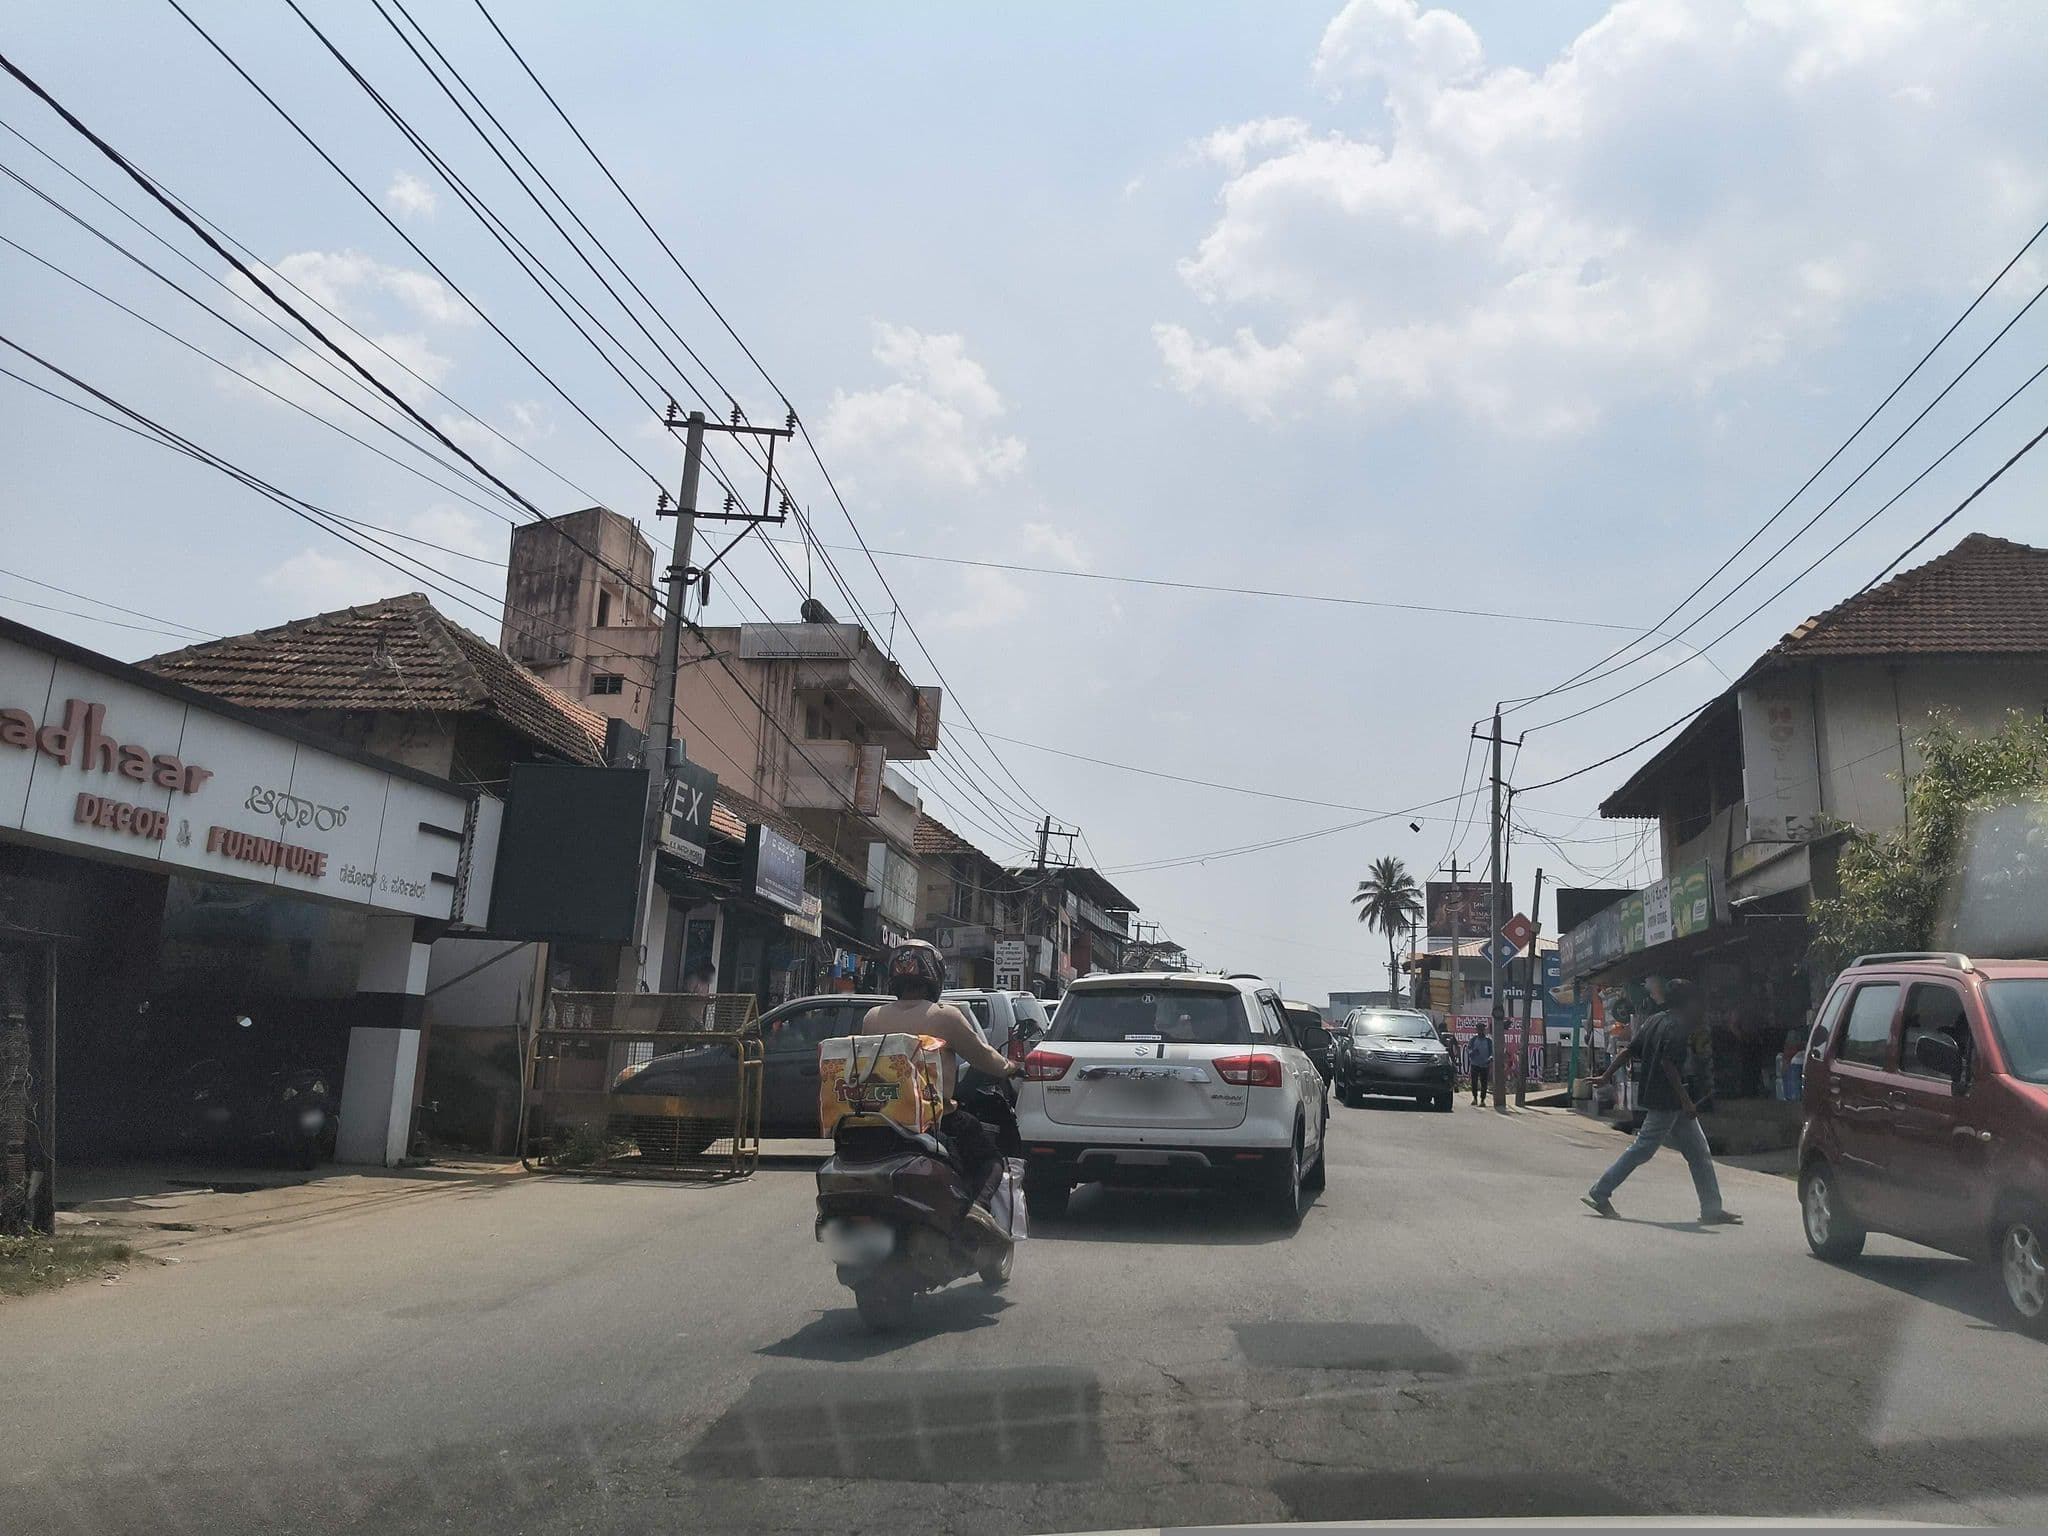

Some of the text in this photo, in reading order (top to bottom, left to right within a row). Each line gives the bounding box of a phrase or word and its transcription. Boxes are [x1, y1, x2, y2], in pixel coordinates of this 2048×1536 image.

[74, 792, 169, 840] DECOR
[206, 826, 329, 878] FURNITURE
[664, 779, 703, 826] EX
